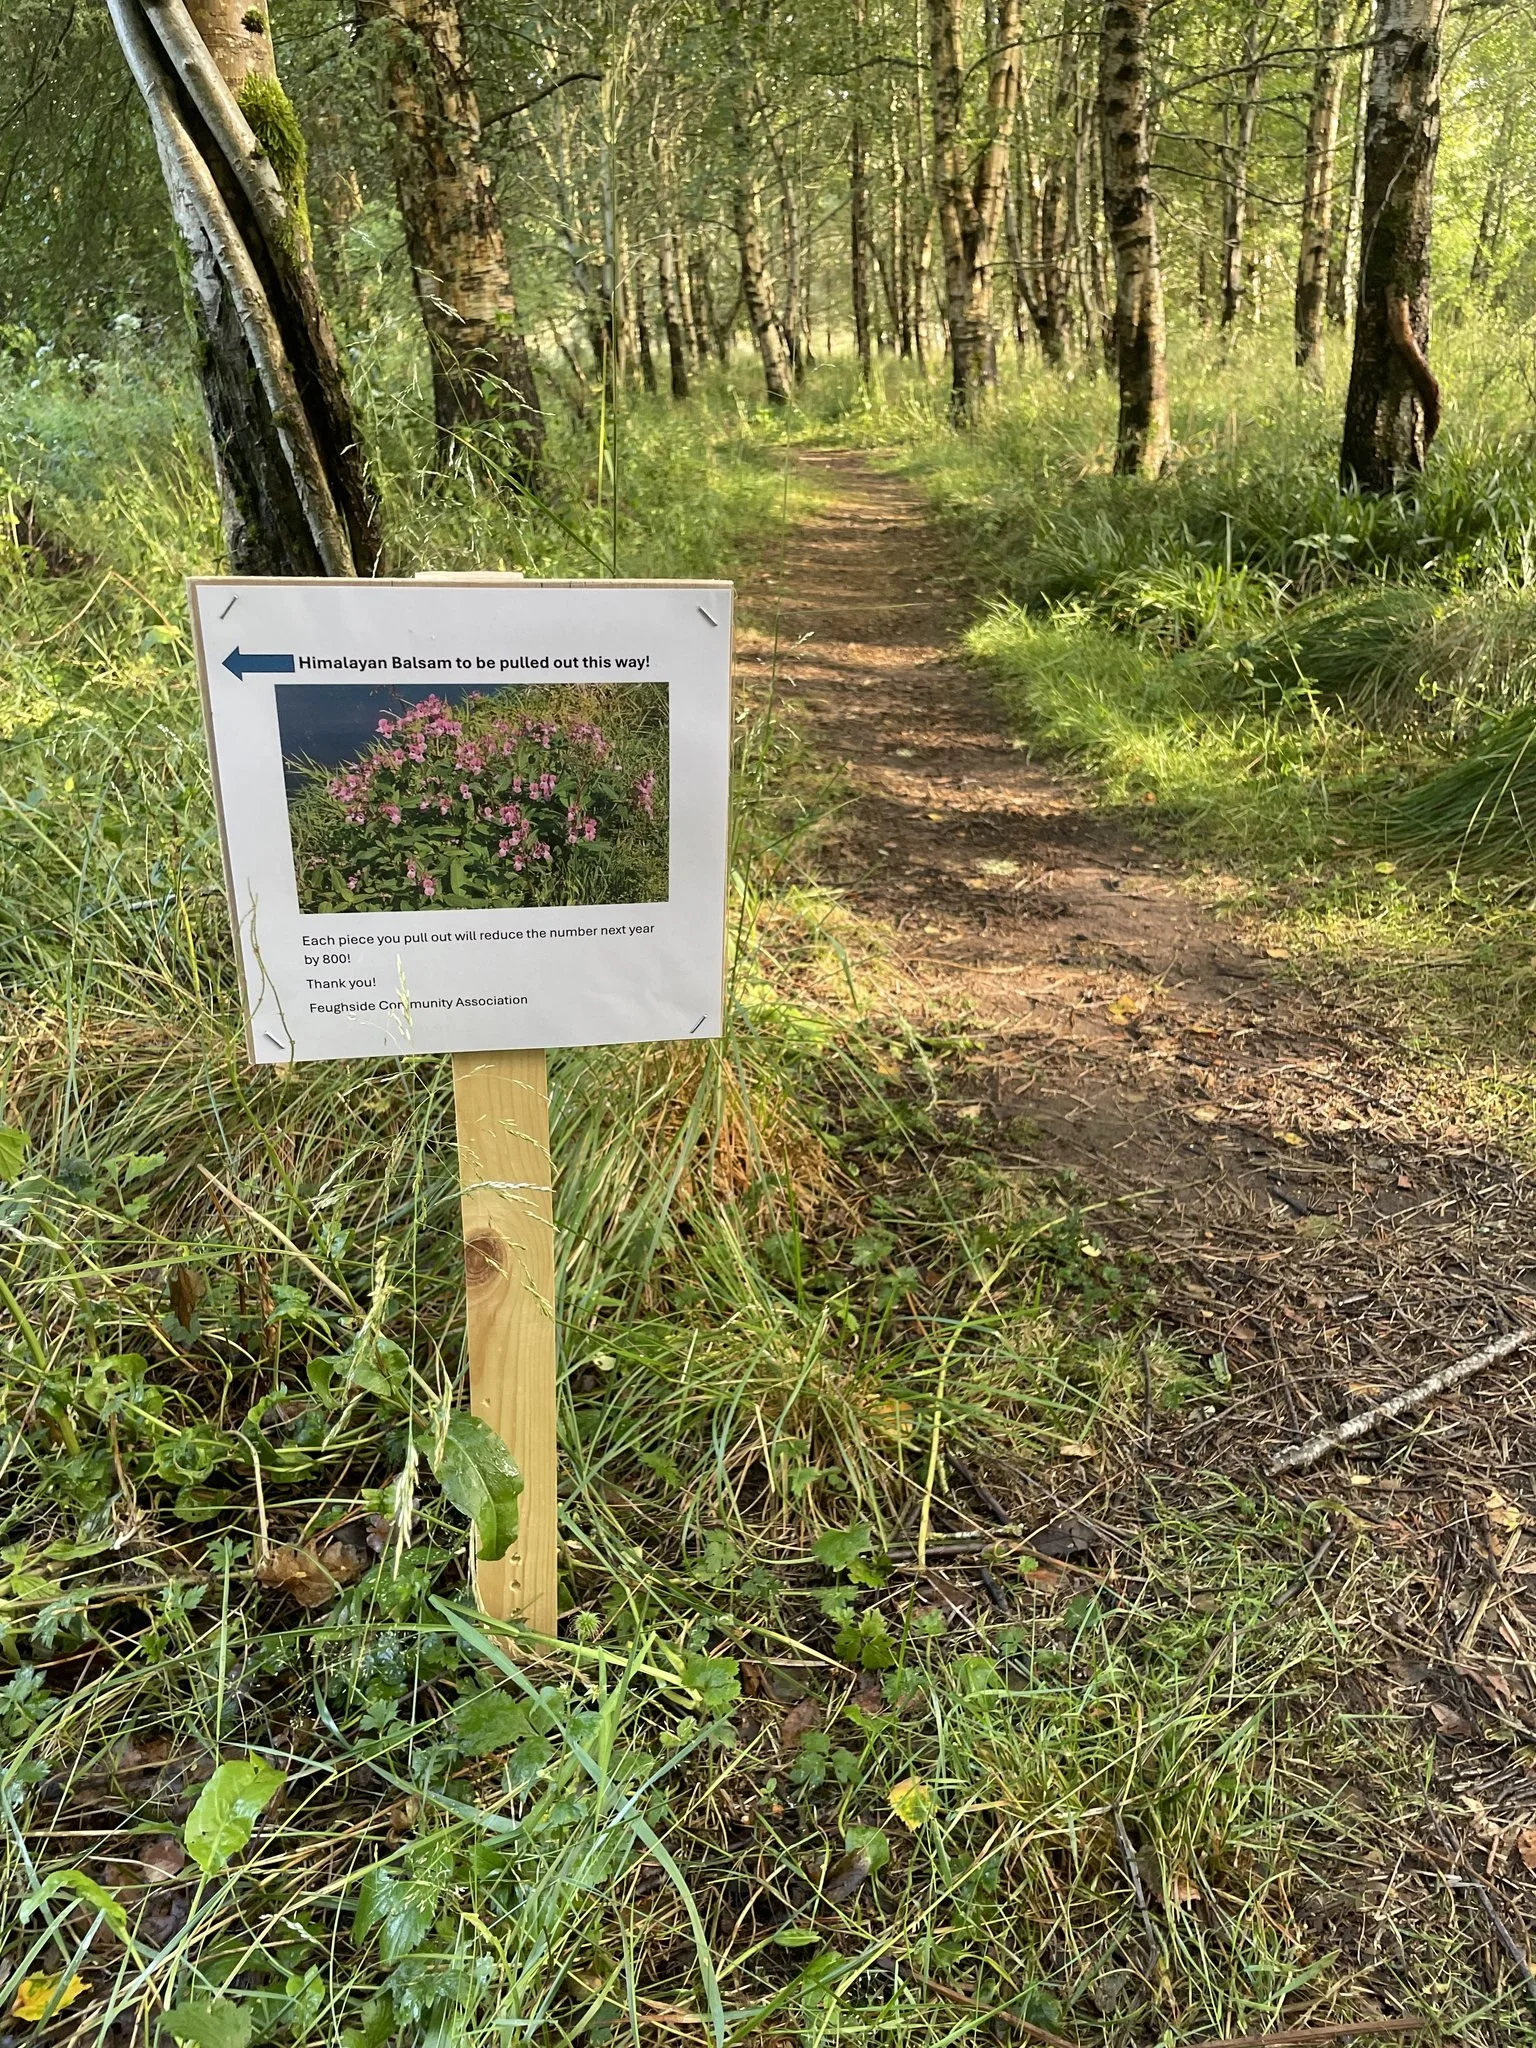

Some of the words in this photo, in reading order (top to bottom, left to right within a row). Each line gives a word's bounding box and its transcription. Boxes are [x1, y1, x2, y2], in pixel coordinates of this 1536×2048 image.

[299, 656, 387, 672] Himalayan
[392, 656, 452, 669] Balsam
[455, 658, 472, 669] to
[476, 656, 495, 669] be
[500, 656, 549, 671] pulled
[554, 657, 579, 668] out
[582, 656, 611, 668] this
[615, 655, 650, 670] way!
[302, 935, 335, 946] Each
[339, 935, 374, 947] piece
[377, 935, 400, 946] you
[404, 933, 428, 945] pull
[431, 933, 452, 942] out
[455, 930, 477, 941] will
[480, 930, 523, 940] reduce
[526, 928, 546, 938] the
[550, 927, 598, 938] number
[601, 925, 626, 935] next
[629, 925, 655, 936] year
[304, 954, 319, 966] by
[323, 954, 351, 964] 800!
[306, 979, 346, 989] Thank
[349, 977, 376, 990] you!
[310, 1001, 376, 1014] Feughside
[456, 996, 528, 1007] Association
